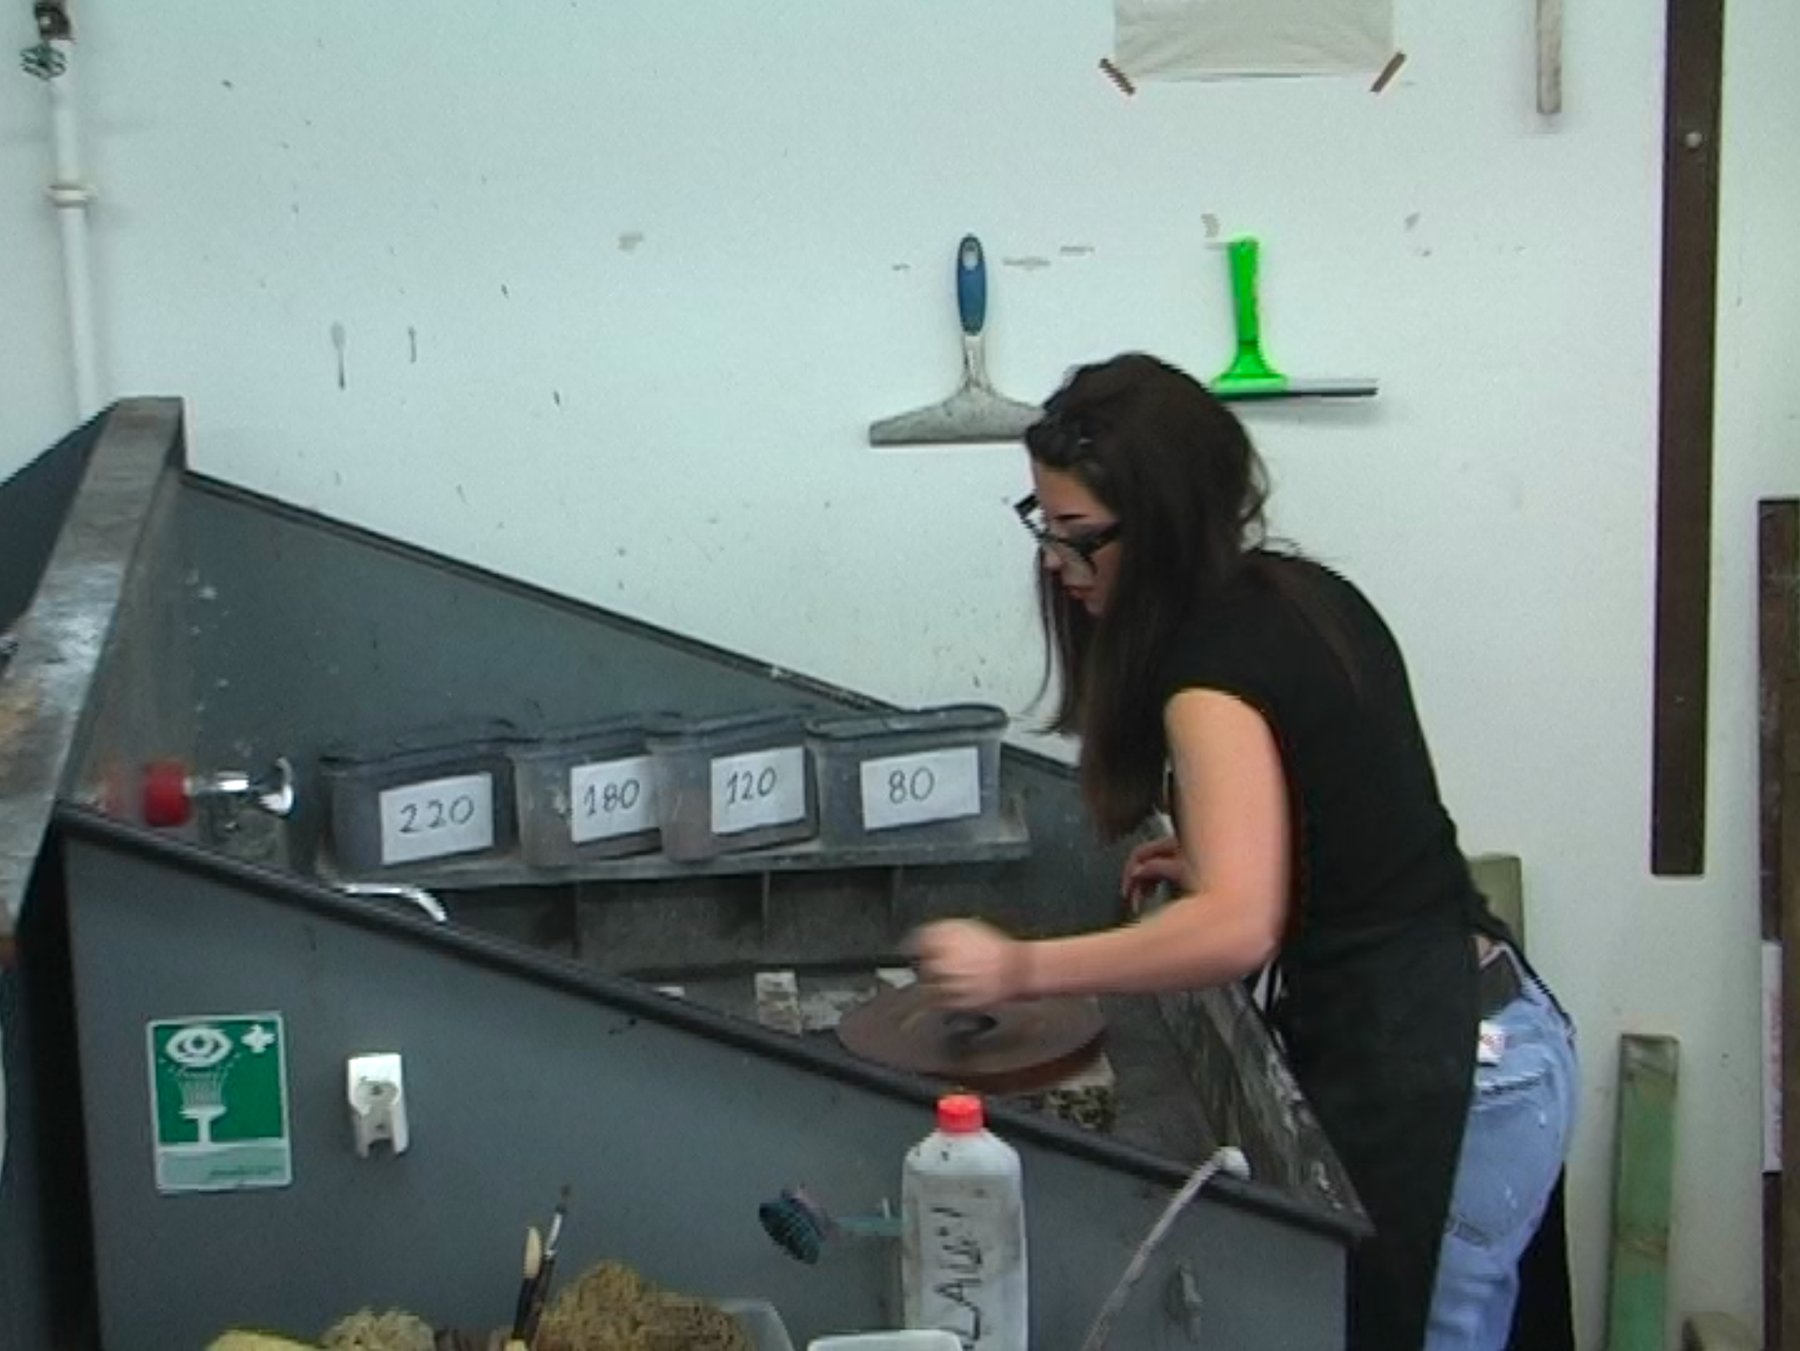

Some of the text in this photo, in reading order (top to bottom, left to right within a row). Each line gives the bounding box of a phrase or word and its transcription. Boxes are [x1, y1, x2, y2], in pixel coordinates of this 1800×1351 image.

[584, 779, 640, 817] 180
[726, 766, 777, 806] 120
[889, 766, 935, 805] 80
[399, 795, 475, 834] 220
